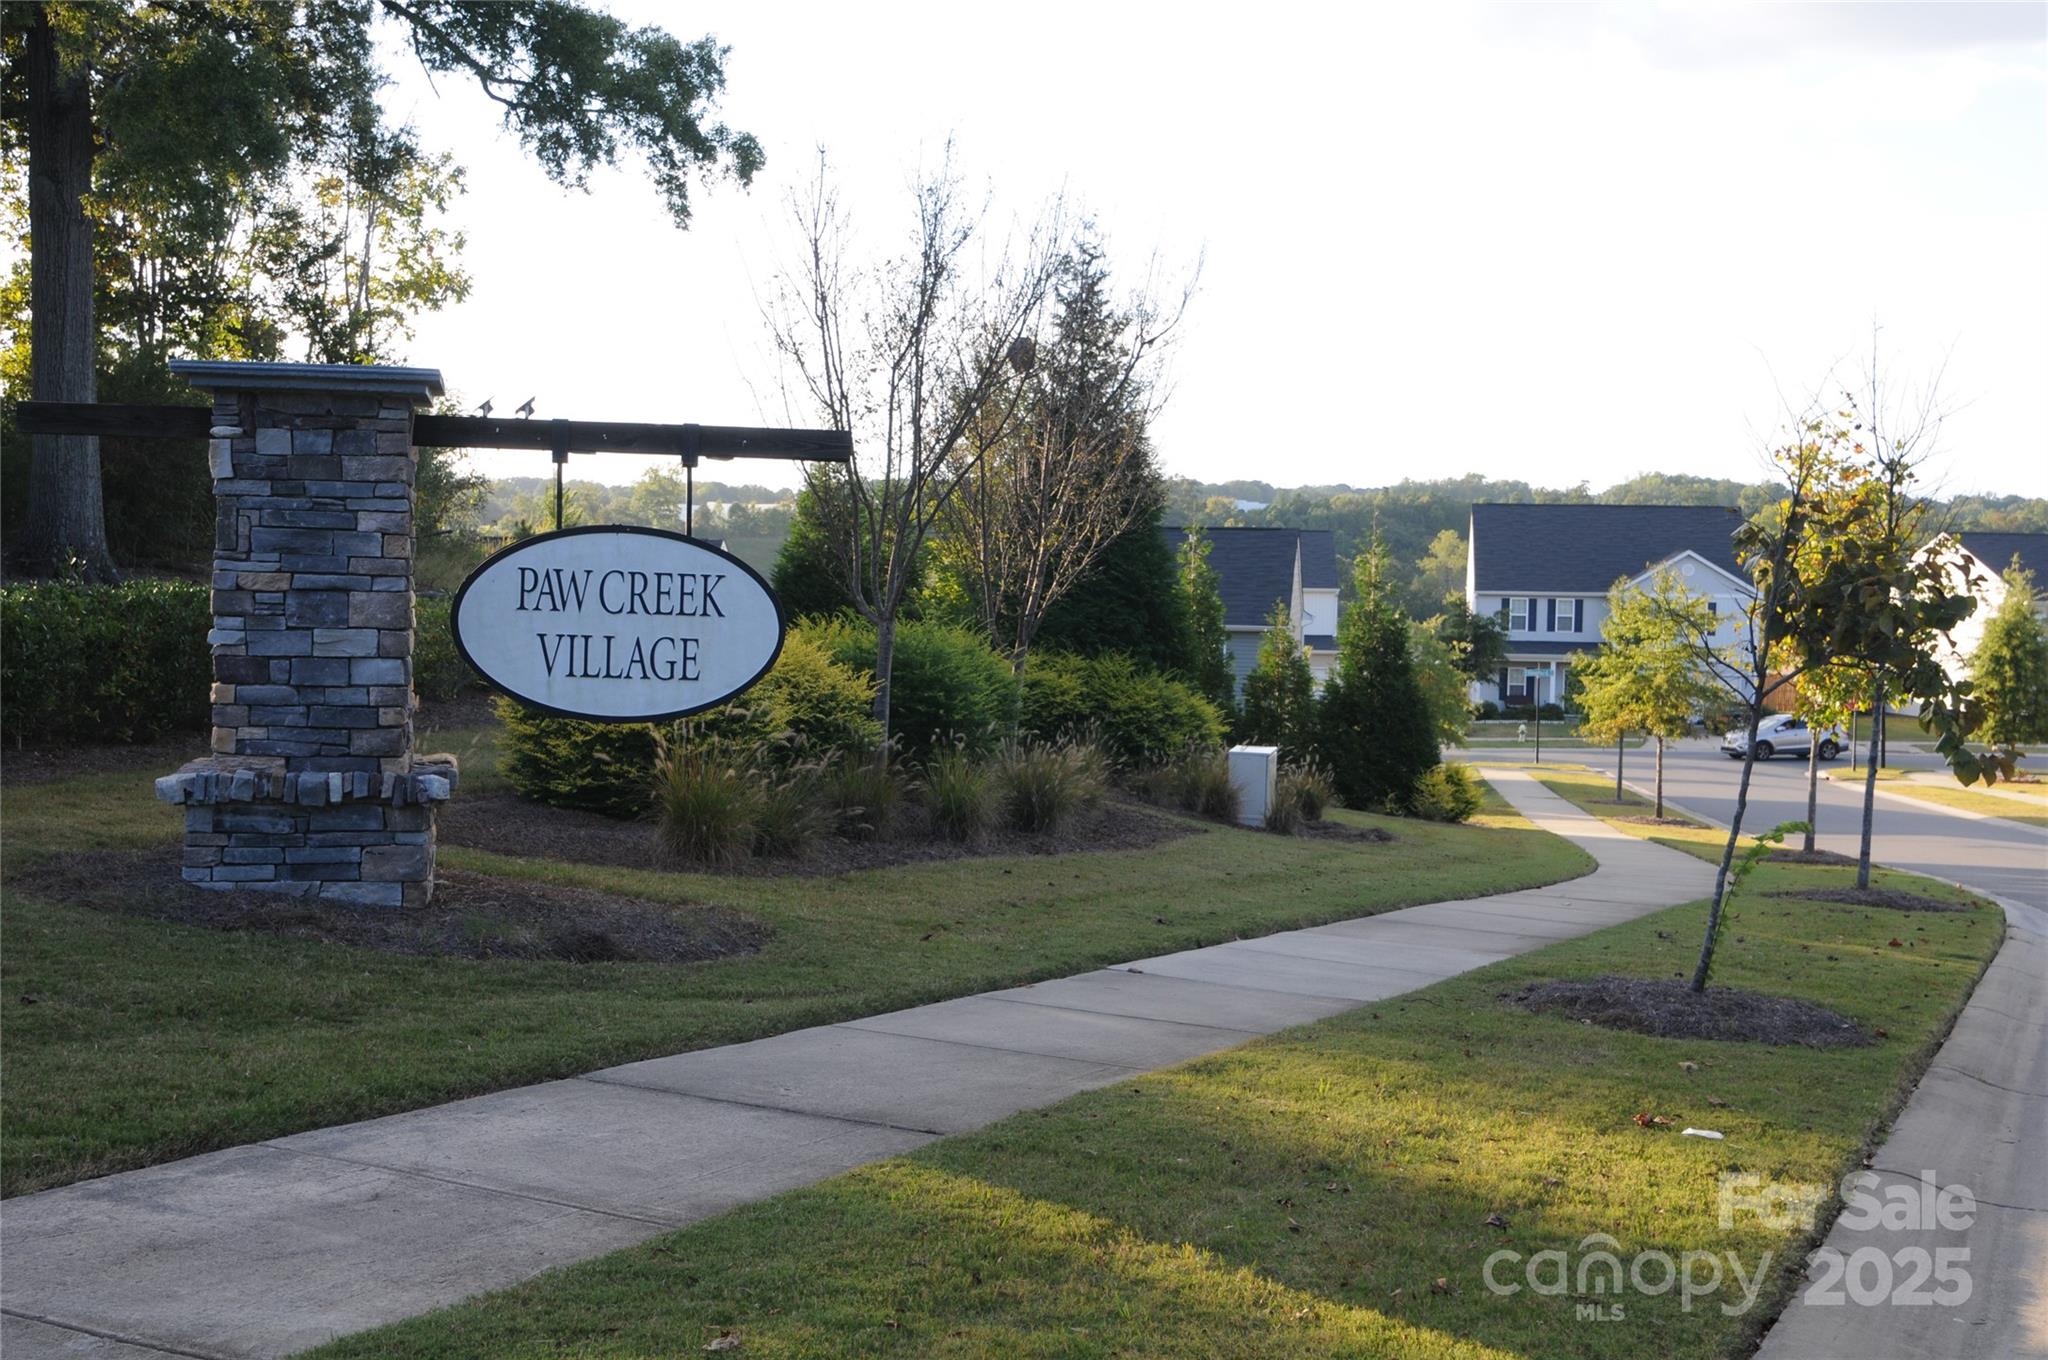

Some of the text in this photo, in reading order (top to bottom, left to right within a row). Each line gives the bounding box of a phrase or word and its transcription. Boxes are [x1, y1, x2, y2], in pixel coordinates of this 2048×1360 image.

[516, 567, 726, 617] PAW CREEK
[536, 633, 701, 681] VILLAGE
